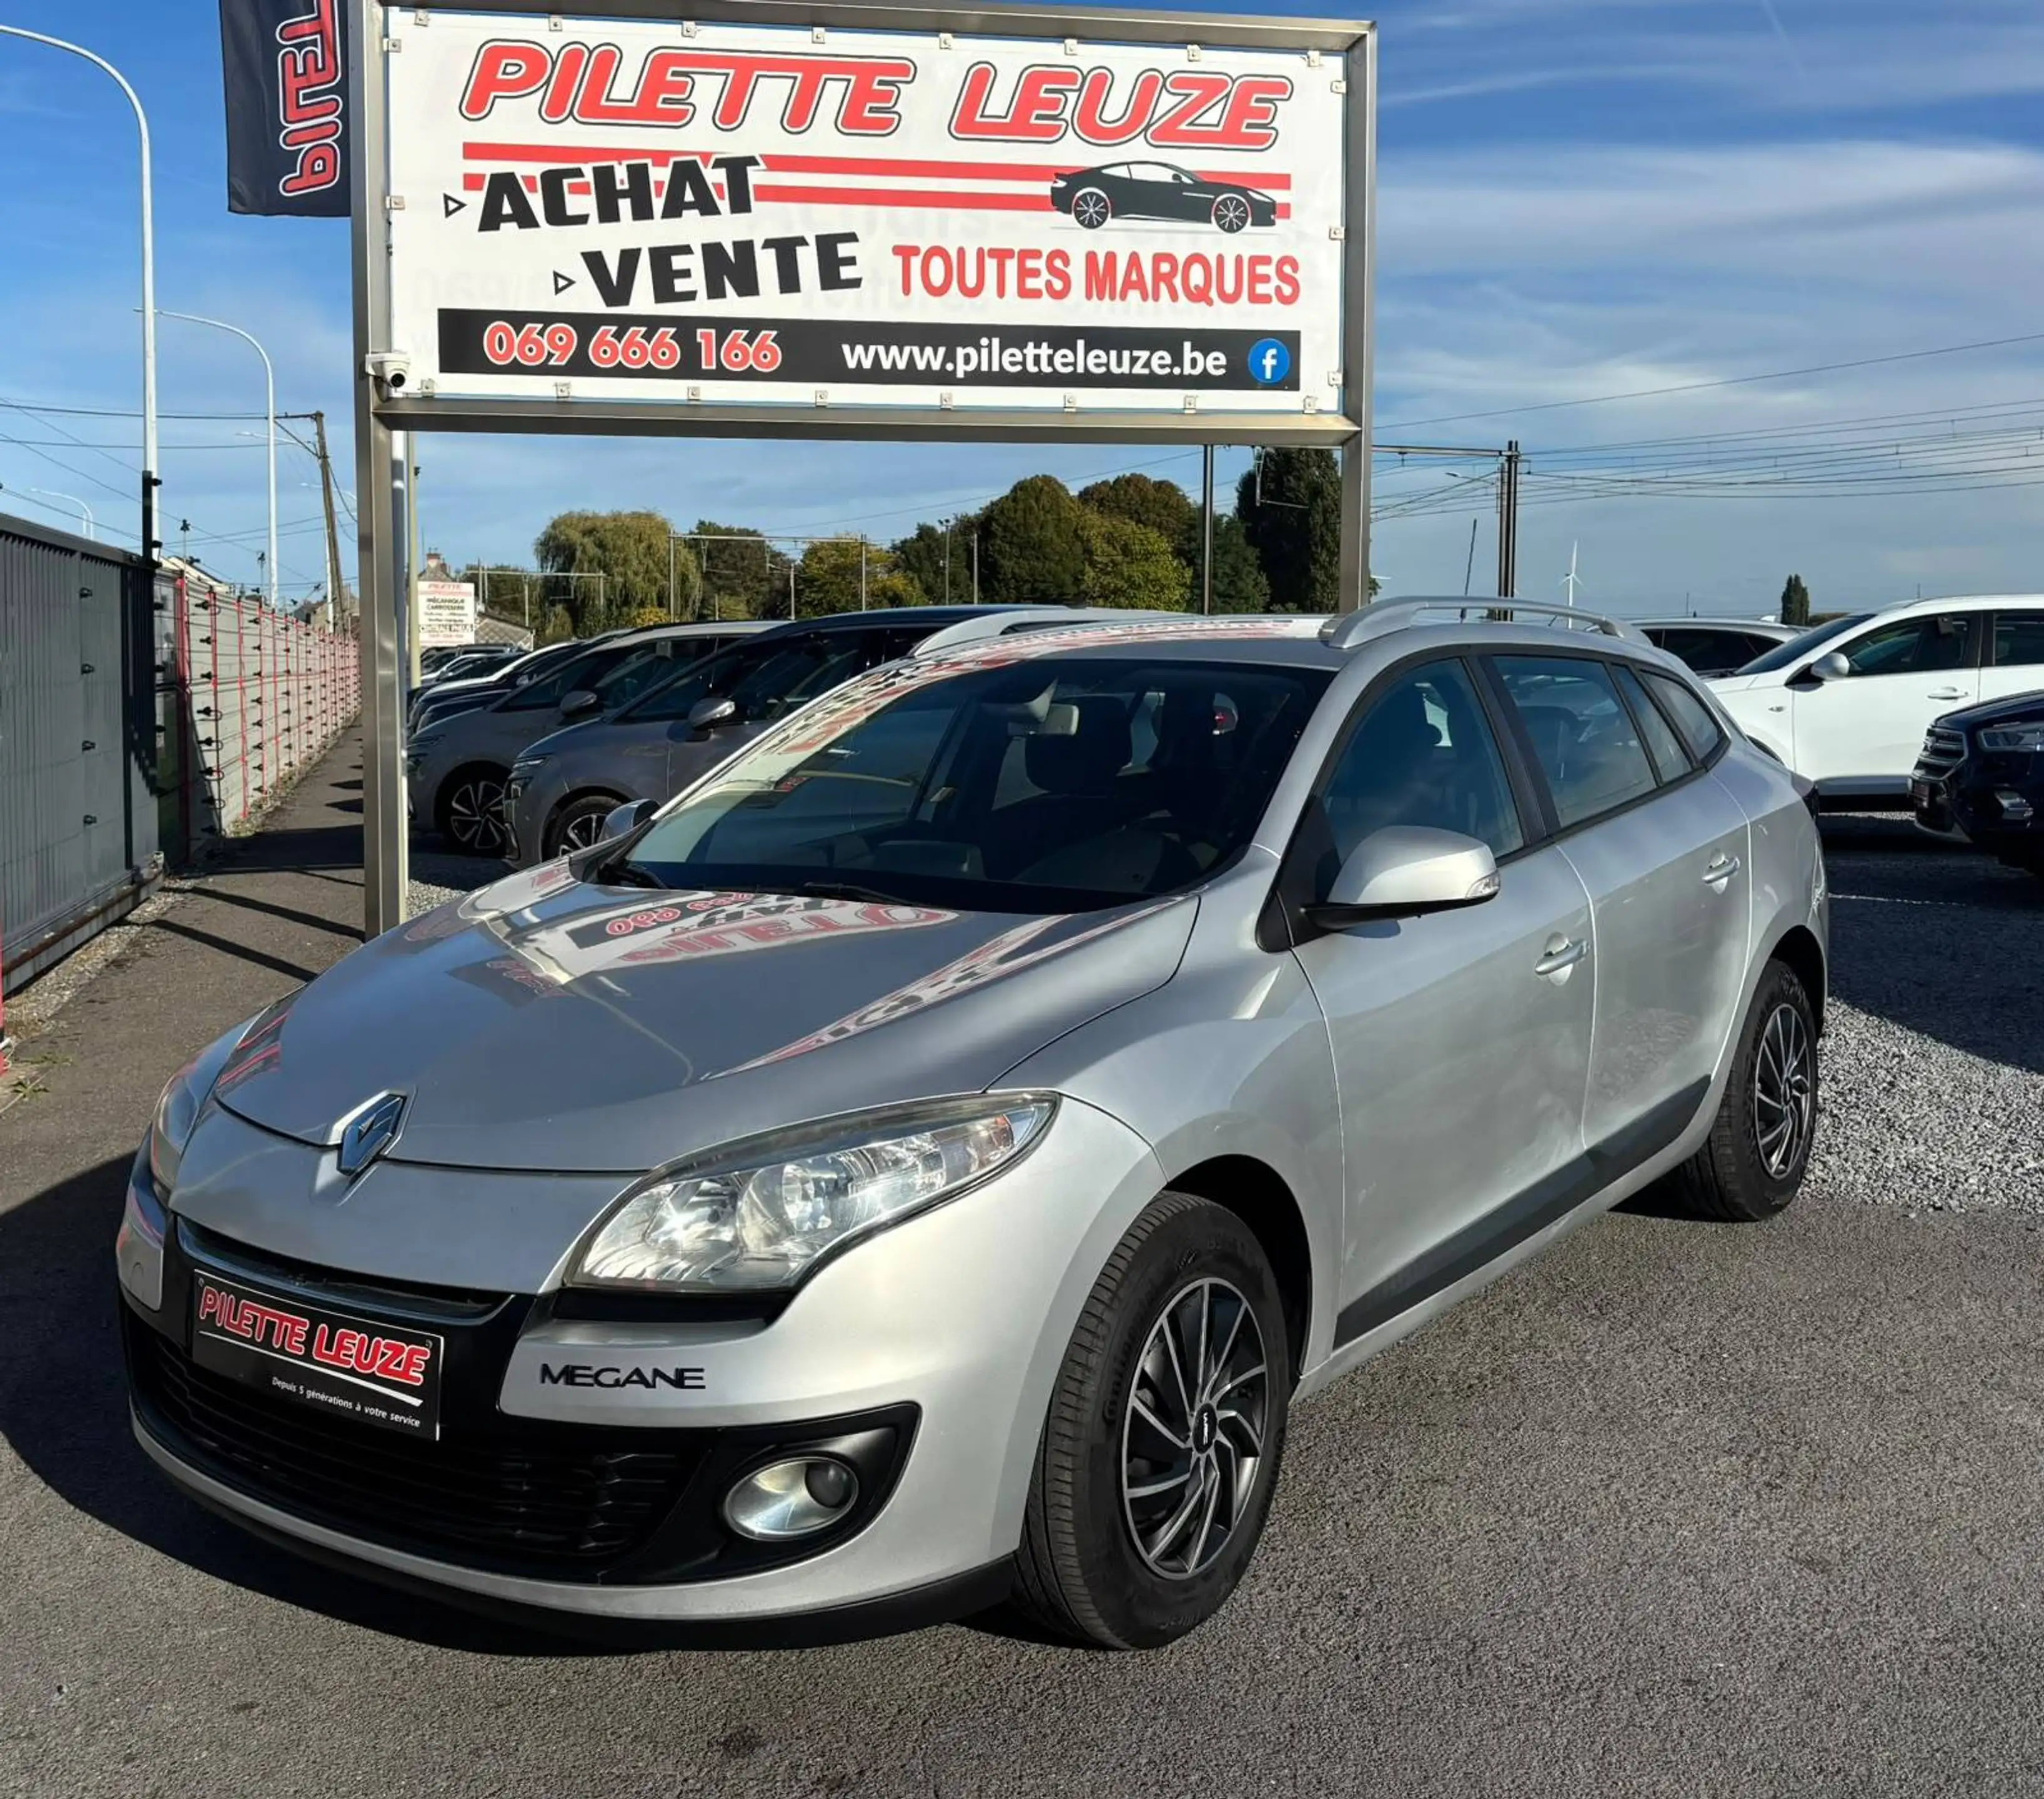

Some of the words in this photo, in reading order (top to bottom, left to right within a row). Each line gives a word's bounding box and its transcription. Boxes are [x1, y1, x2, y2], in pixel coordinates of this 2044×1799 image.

[459, 39, 916, 136] PILETTE
[949, 61, 1293, 151] LEUZE
[478, 155, 760, 232] ACHAT
[581, 232, 862, 307] VENTE
[892, 245, 1072, 300] TOUTES
[1084, 250, 1300, 307] MARQUES
[483, 321, 577, 366] 069
[588, 326, 680, 369] 666
[696, 328, 782, 372] 166
[841, 338, 1227, 378] www.piletteleuze.be
[199, 1286, 310, 1355] PILETTE
[312, 1324, 431, 1386] LEUZE
[272, 1376, 297, 1392] Depuis
[299, 1385, 304, 1394] 5
[305, 1388, 353, 1410] générations
[355, 1401, 362, 1412] à
[364, 1405, 388, 1419] votre
[390, 1412, 421, 1428] service
[540, 1363, 706, 1389] MEGANE
